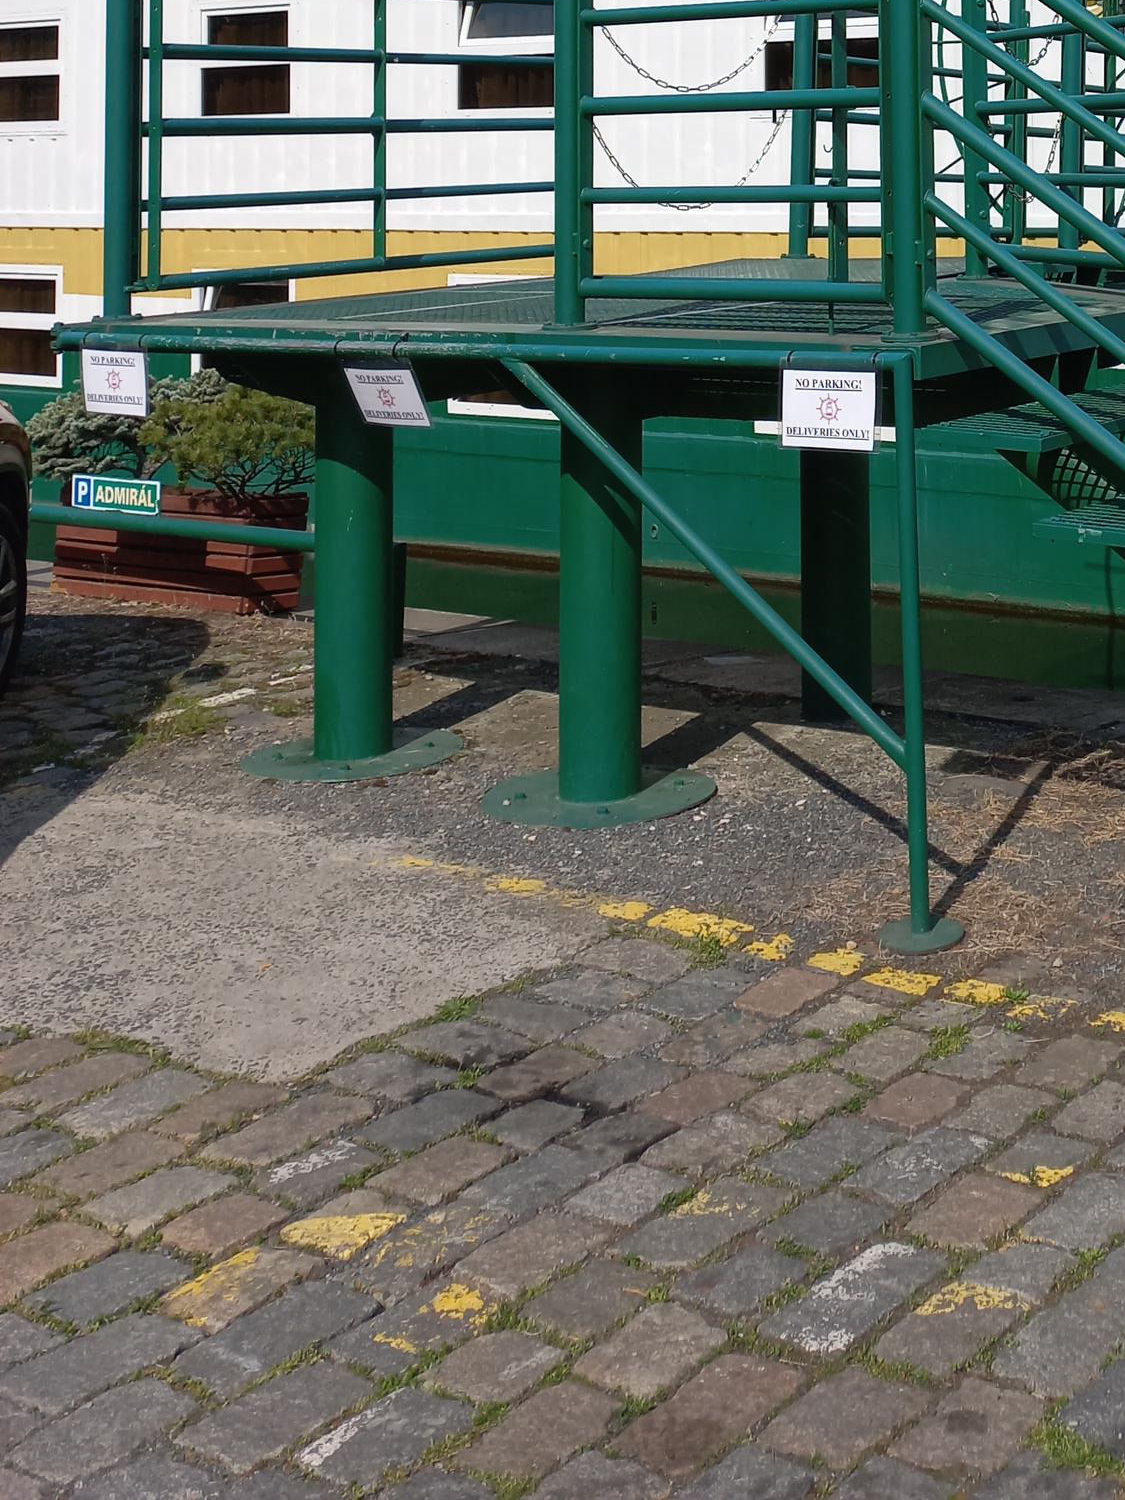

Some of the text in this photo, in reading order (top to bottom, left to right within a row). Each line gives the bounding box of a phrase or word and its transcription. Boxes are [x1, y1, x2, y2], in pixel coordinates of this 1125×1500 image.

[90, 355, 135, 365] NO PARKING!
[354, 374, 366, 382] NO
[796, 378, 862, 390] NO PARKING!
[87, 393, 123, 403] DELIVERIES
[786, 426, 870, 439] DELIVERIES ONLY!
[77, 481, 155, 508] P ADMIRÁL
